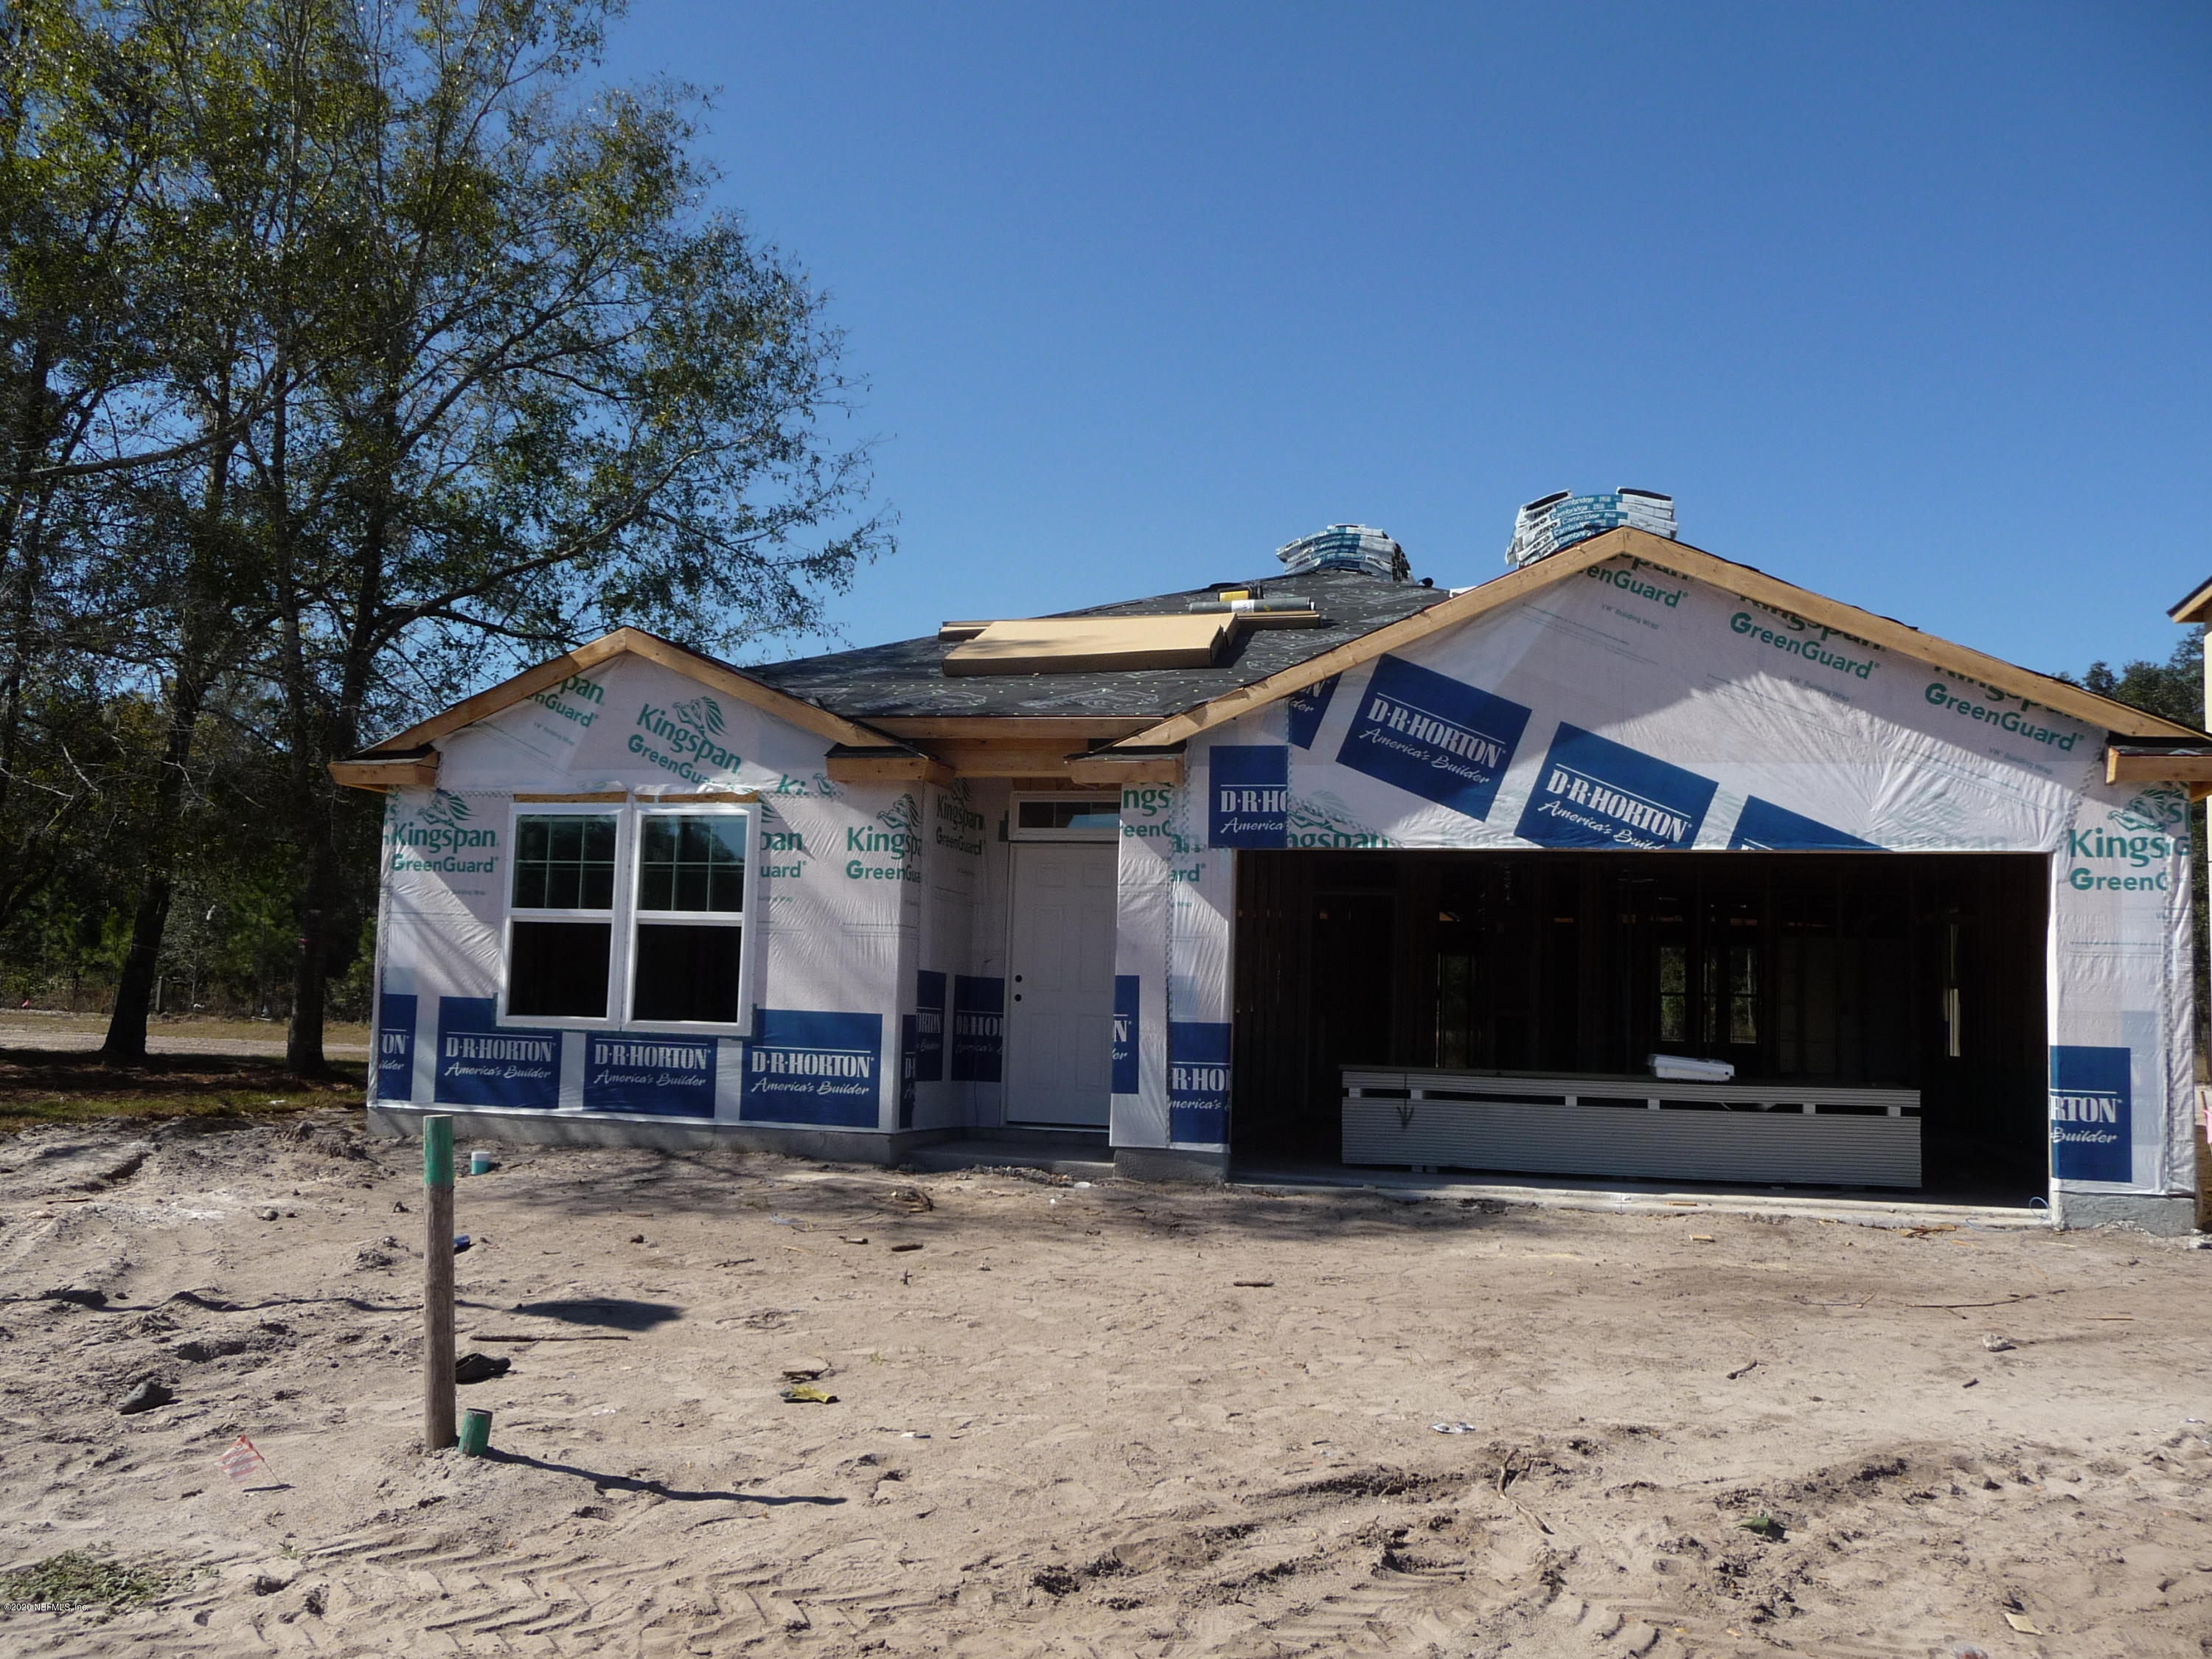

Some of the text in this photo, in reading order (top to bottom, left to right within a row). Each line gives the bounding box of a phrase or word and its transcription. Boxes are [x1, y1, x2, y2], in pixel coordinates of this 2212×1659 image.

[1730, 612, 1874, 680] GreenGuard
[1924, 683, 2078, 752] GreenGuard
[636, 703, 742, 774] Kingspan
[1359, 727, 1490, 785] America's Builder
[1537, 800, 1613, 835] America's
[391, 821, 497, 854] Kingspan
[390, 853, 495, 874] GreenGuard
[444, 1061, 552, 1079] America's Builder
[593, 1068, 707, 1088] America's Builder
[751, 1077, 871, 1096] America's Builder
[2053, 1127, 2117, 1144] Builder
